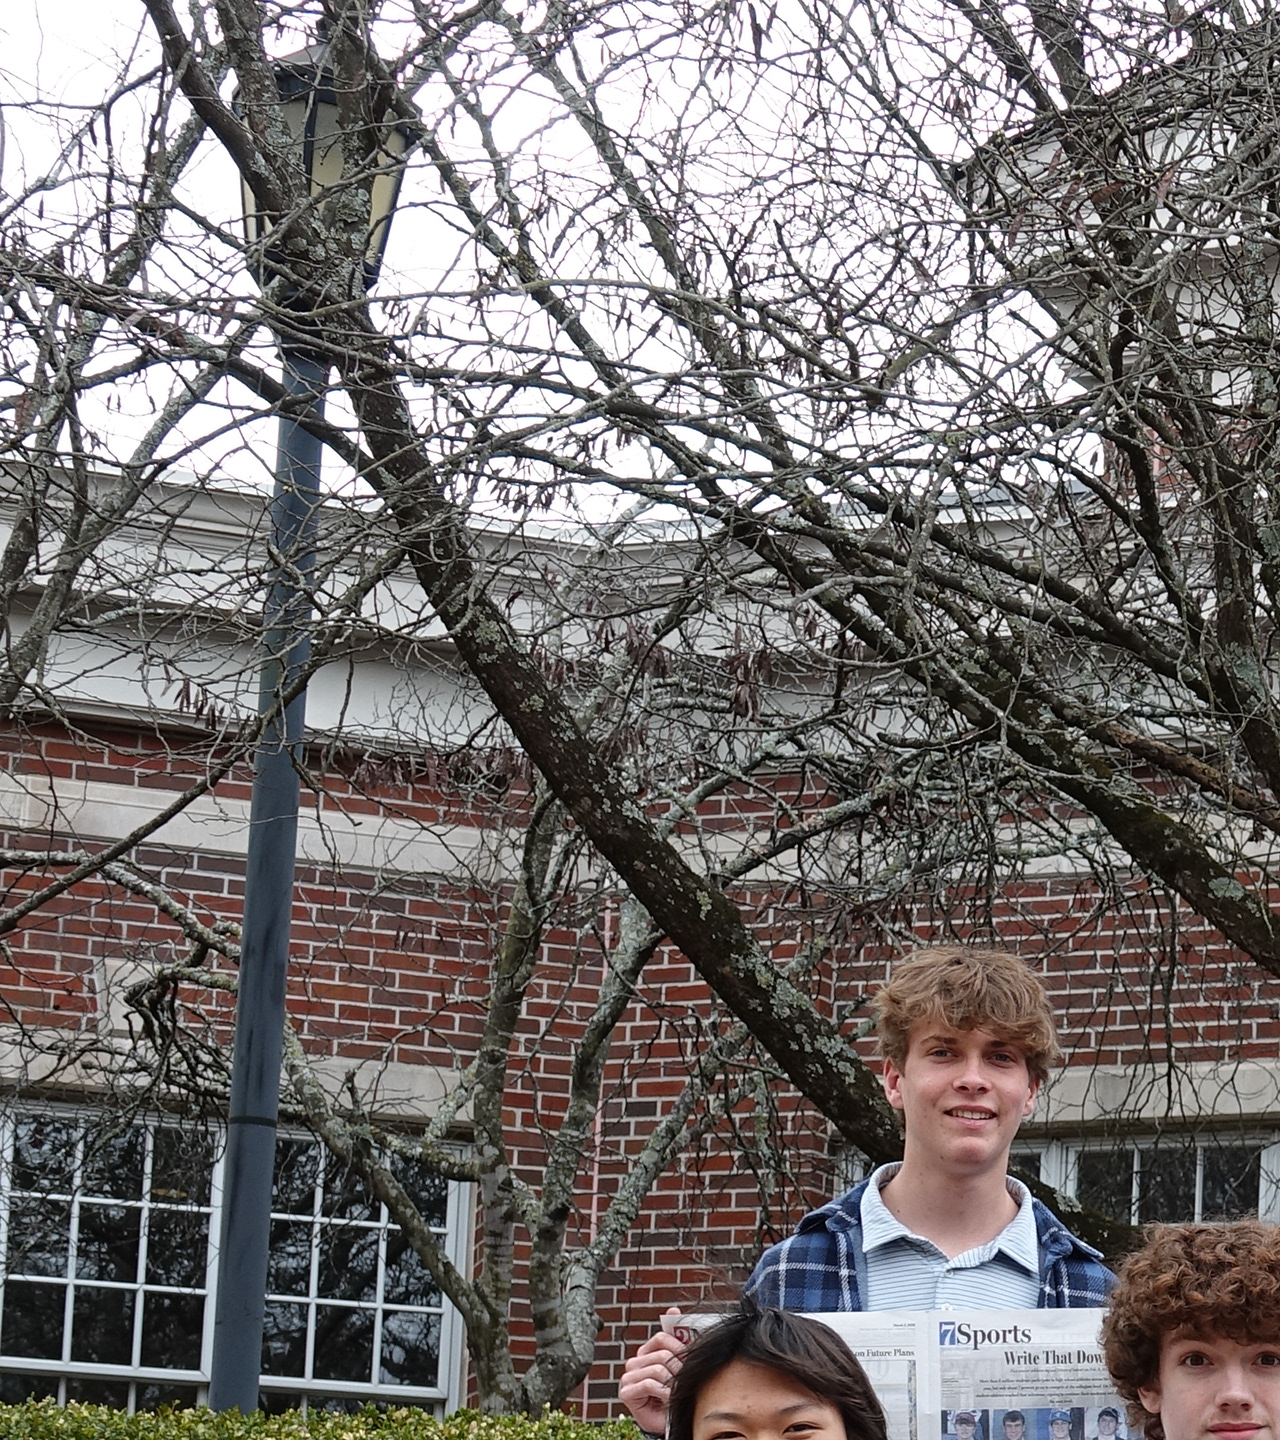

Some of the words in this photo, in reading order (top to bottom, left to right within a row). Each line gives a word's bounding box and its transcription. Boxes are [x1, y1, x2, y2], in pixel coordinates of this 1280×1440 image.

[957, 1323, 1032, 1350] Sports
[866, 1349, 892, 1357] Future
[893, 1348, 915, 1357] Plans
[1004, 1351, 1040, 1366] Write
[1043, 1350, 1073, 1364] That
[1077, 1349, 1103, 1364] Dow
